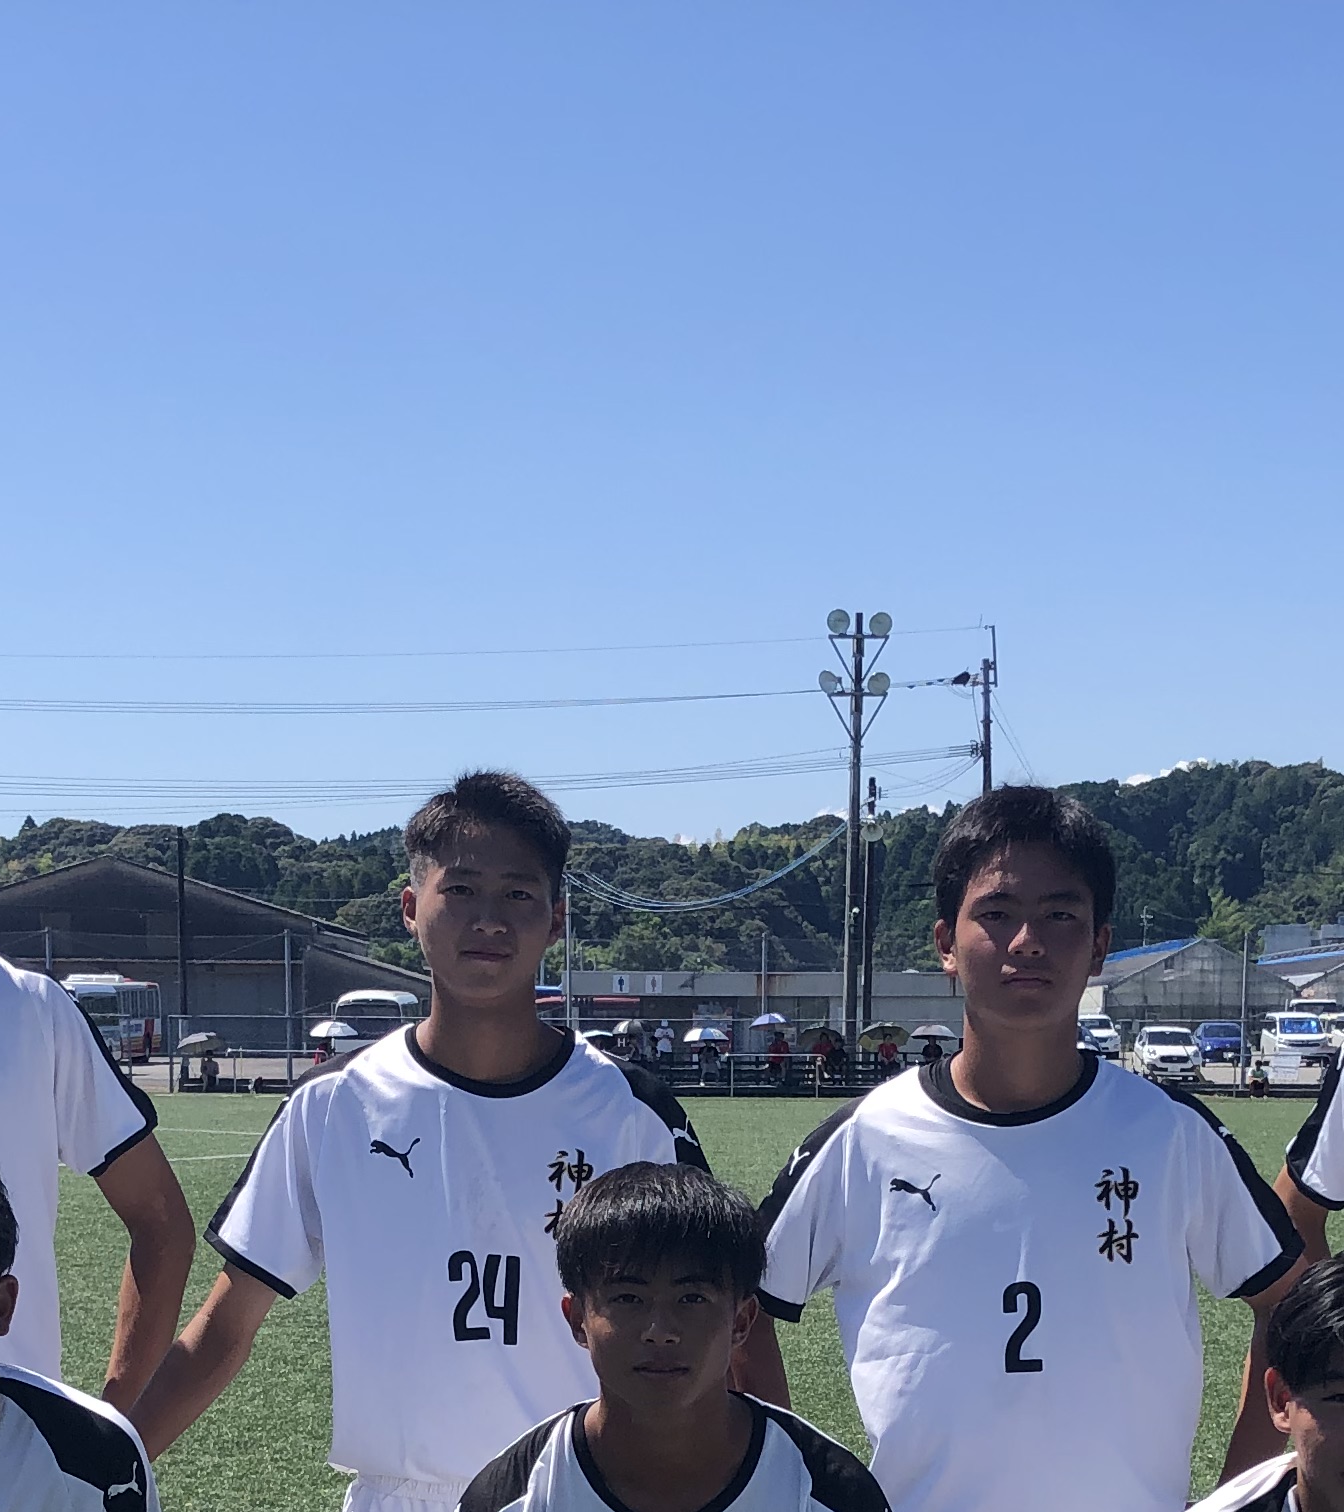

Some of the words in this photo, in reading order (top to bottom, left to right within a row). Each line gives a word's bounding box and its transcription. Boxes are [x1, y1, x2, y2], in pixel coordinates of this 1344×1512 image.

[1093, 1166, 1140, 1265] 神村
[447, 1250, 521, 1346] 24
[1002, 1281, 1044, 1374] 2
